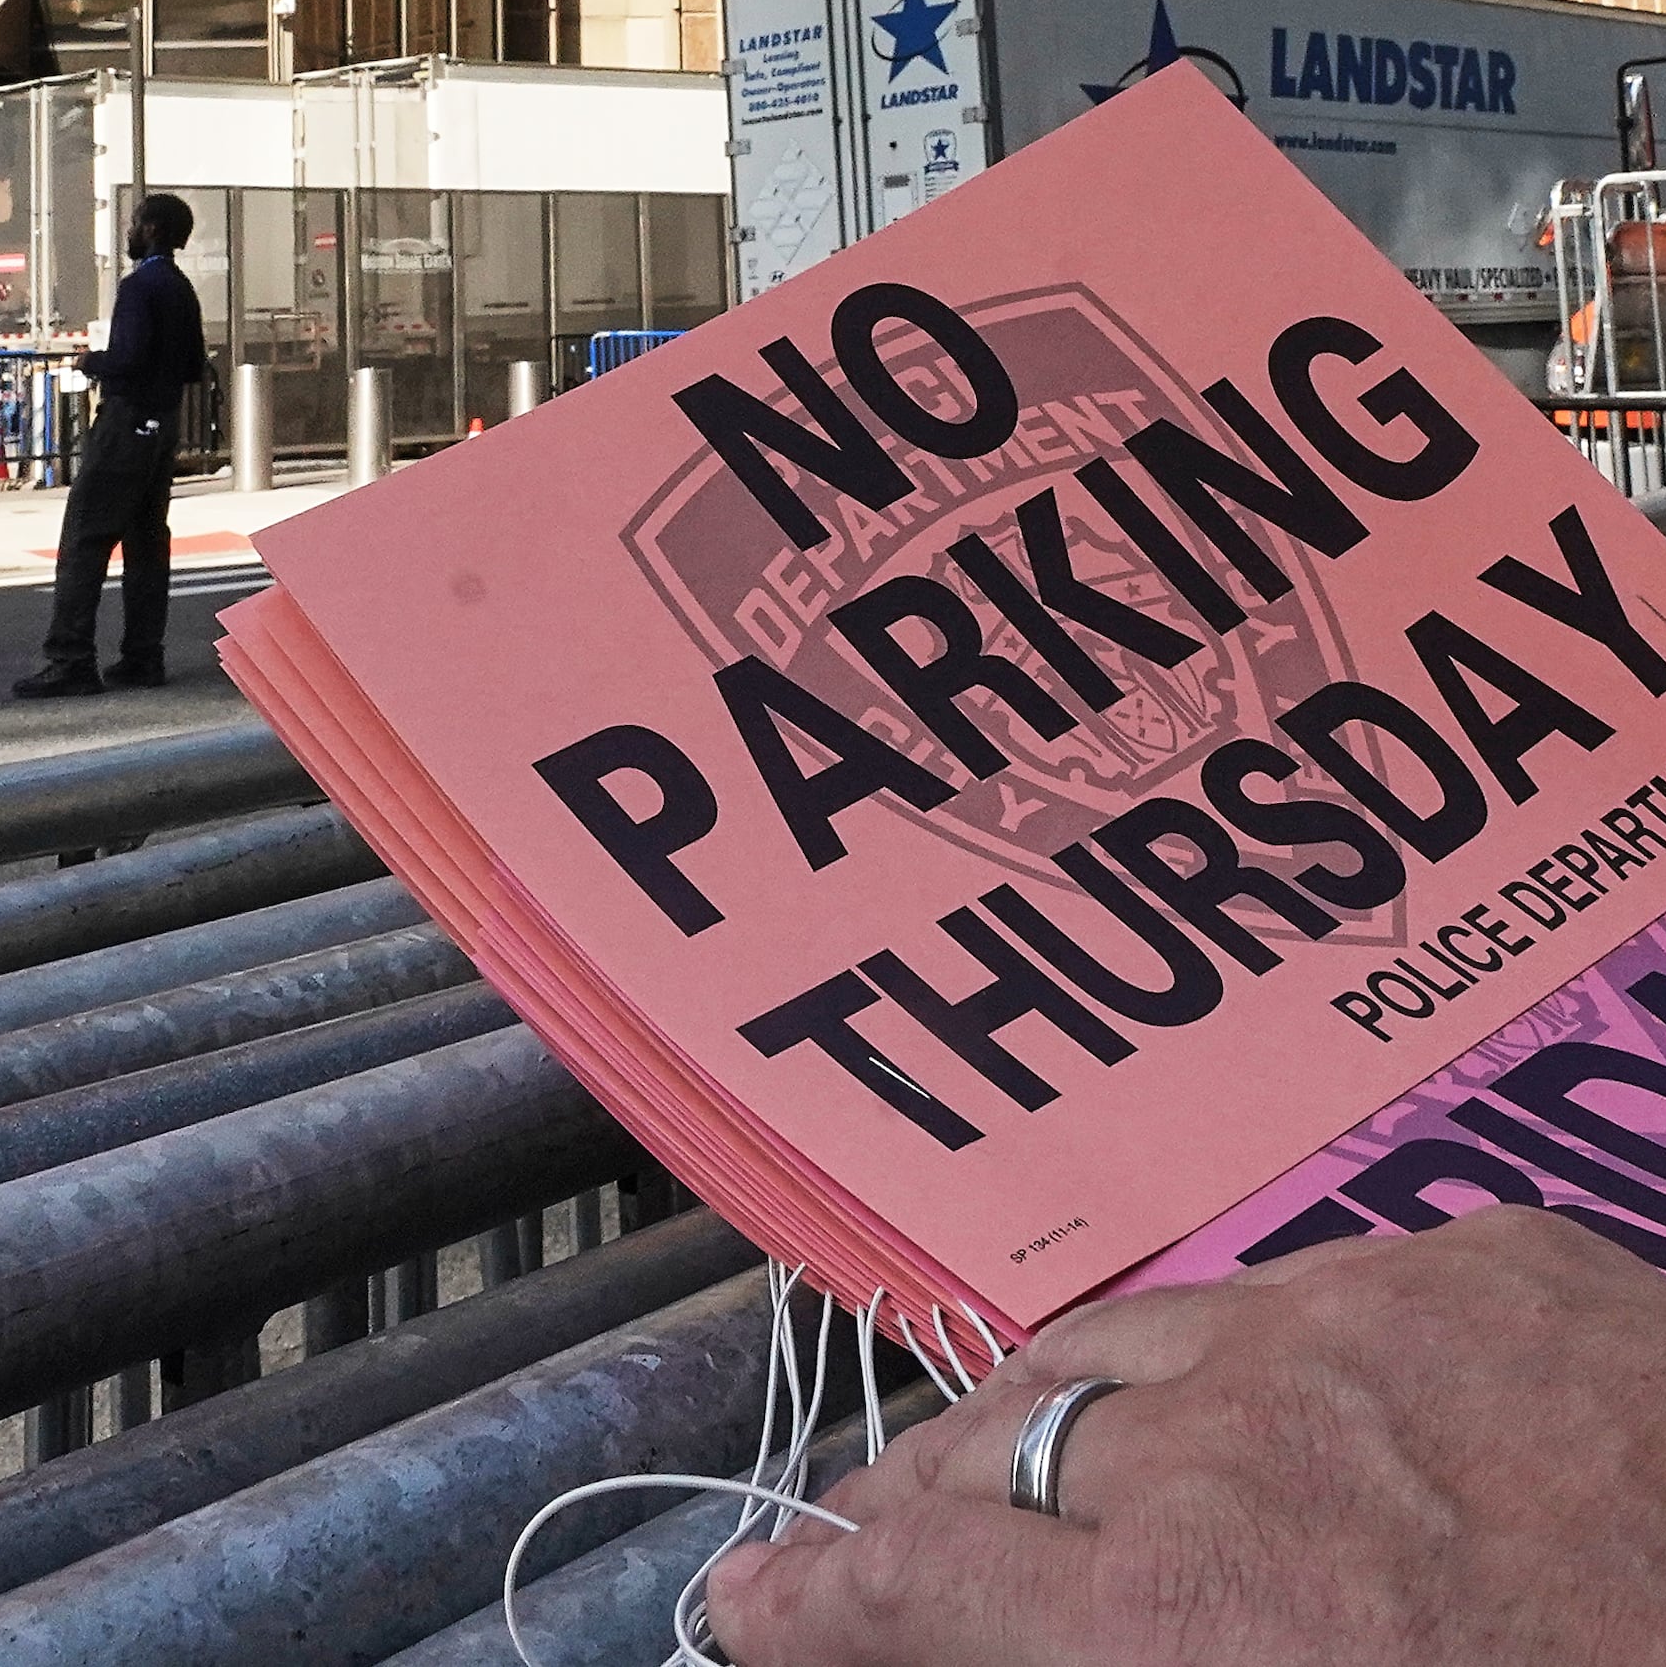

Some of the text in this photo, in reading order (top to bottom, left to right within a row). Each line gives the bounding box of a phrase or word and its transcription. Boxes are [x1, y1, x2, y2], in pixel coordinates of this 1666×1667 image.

[738, 25, 823, 53] LANDSTAR
[1270, 27, 1517, 115] LANDSTAR
[880, 84, 960, 110] LANDSTAR
[672, 282, 1019, 551] NO
[533, 317, 1480, 937] PARKING
[1330, 903, 1537, 1044] POLICE
[1010, 1249, 1027, 1264] SP
[1048, 1217, 1090, 1243] (11-14)
